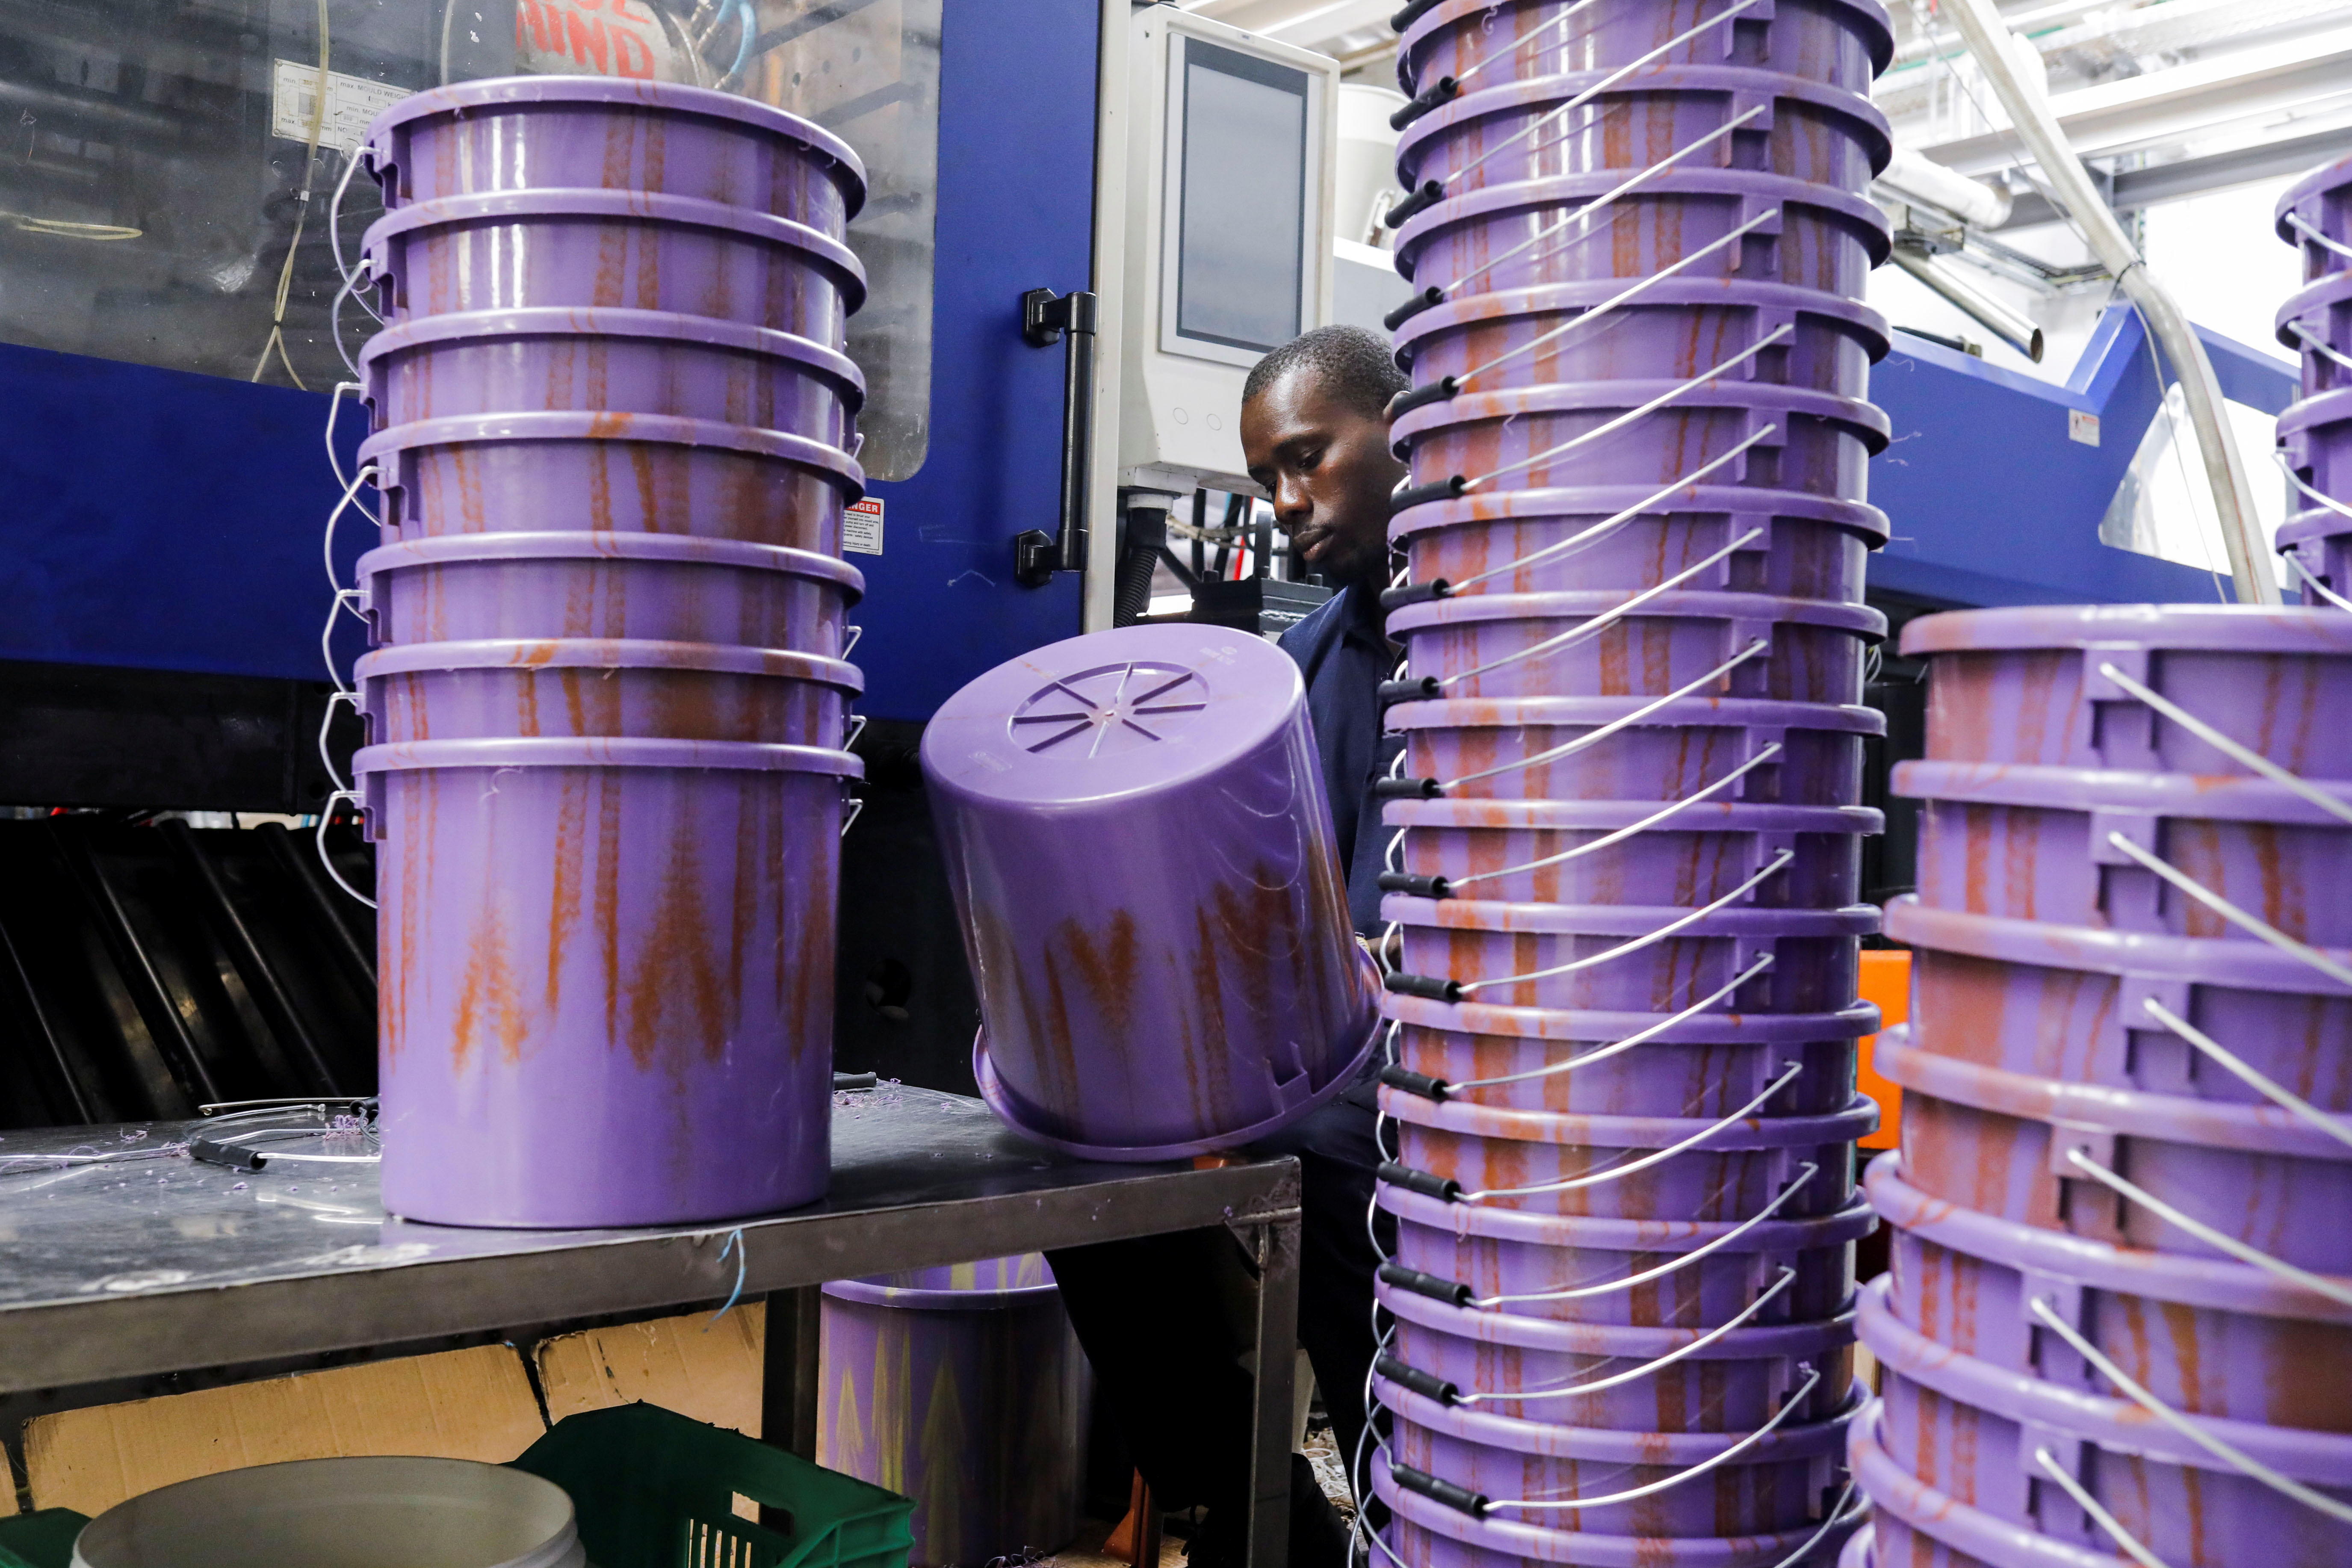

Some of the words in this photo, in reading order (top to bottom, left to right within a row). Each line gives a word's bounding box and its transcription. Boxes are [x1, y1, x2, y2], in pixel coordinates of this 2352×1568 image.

[358, 85, 382, 94] MOULD
[383, 90, 409, 99] WEIGH
[849, 503, 878, 513] NGER
